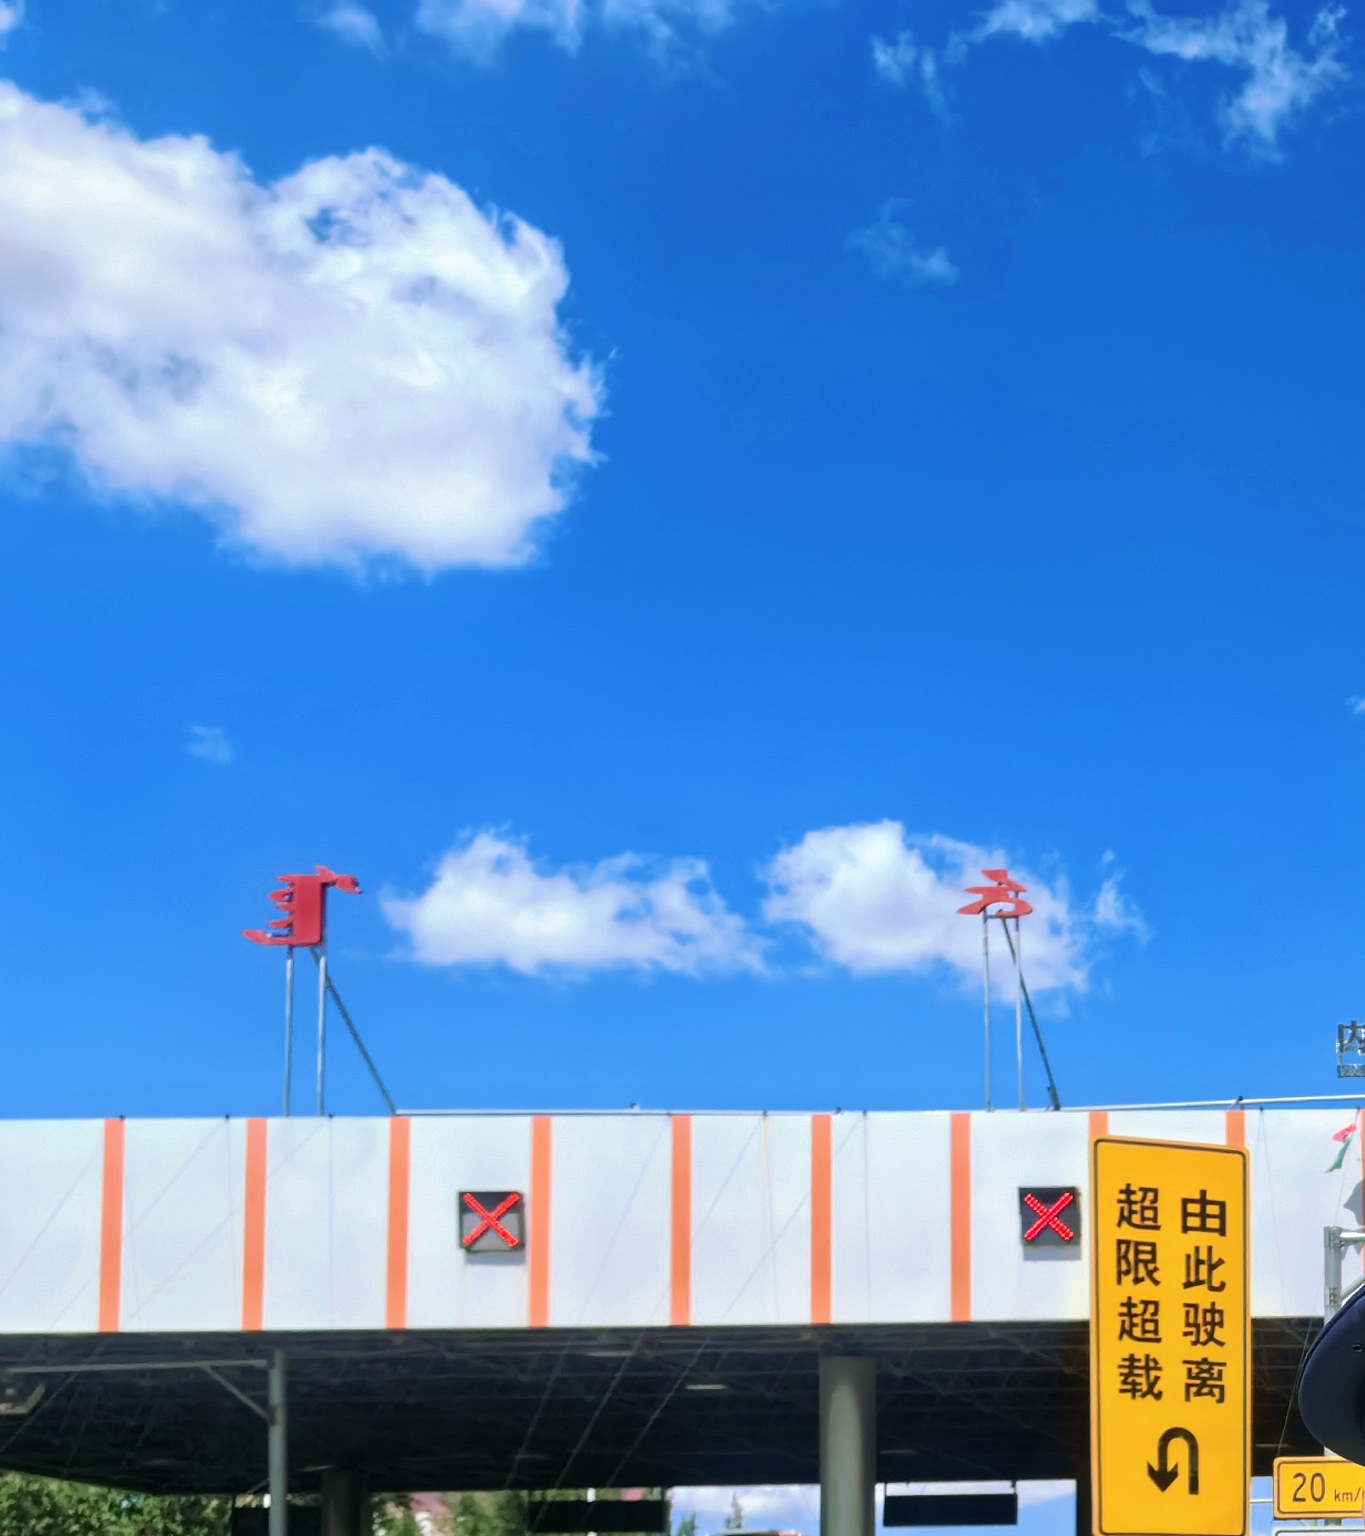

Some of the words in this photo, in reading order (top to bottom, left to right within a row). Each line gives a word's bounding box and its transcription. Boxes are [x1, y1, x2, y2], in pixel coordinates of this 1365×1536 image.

[1115, 1182, 1164, 1402] 超限超载
[1180, 1188, 1228, 1405] 由此驶离
[1292, 1472, 1326, 1503] 20
